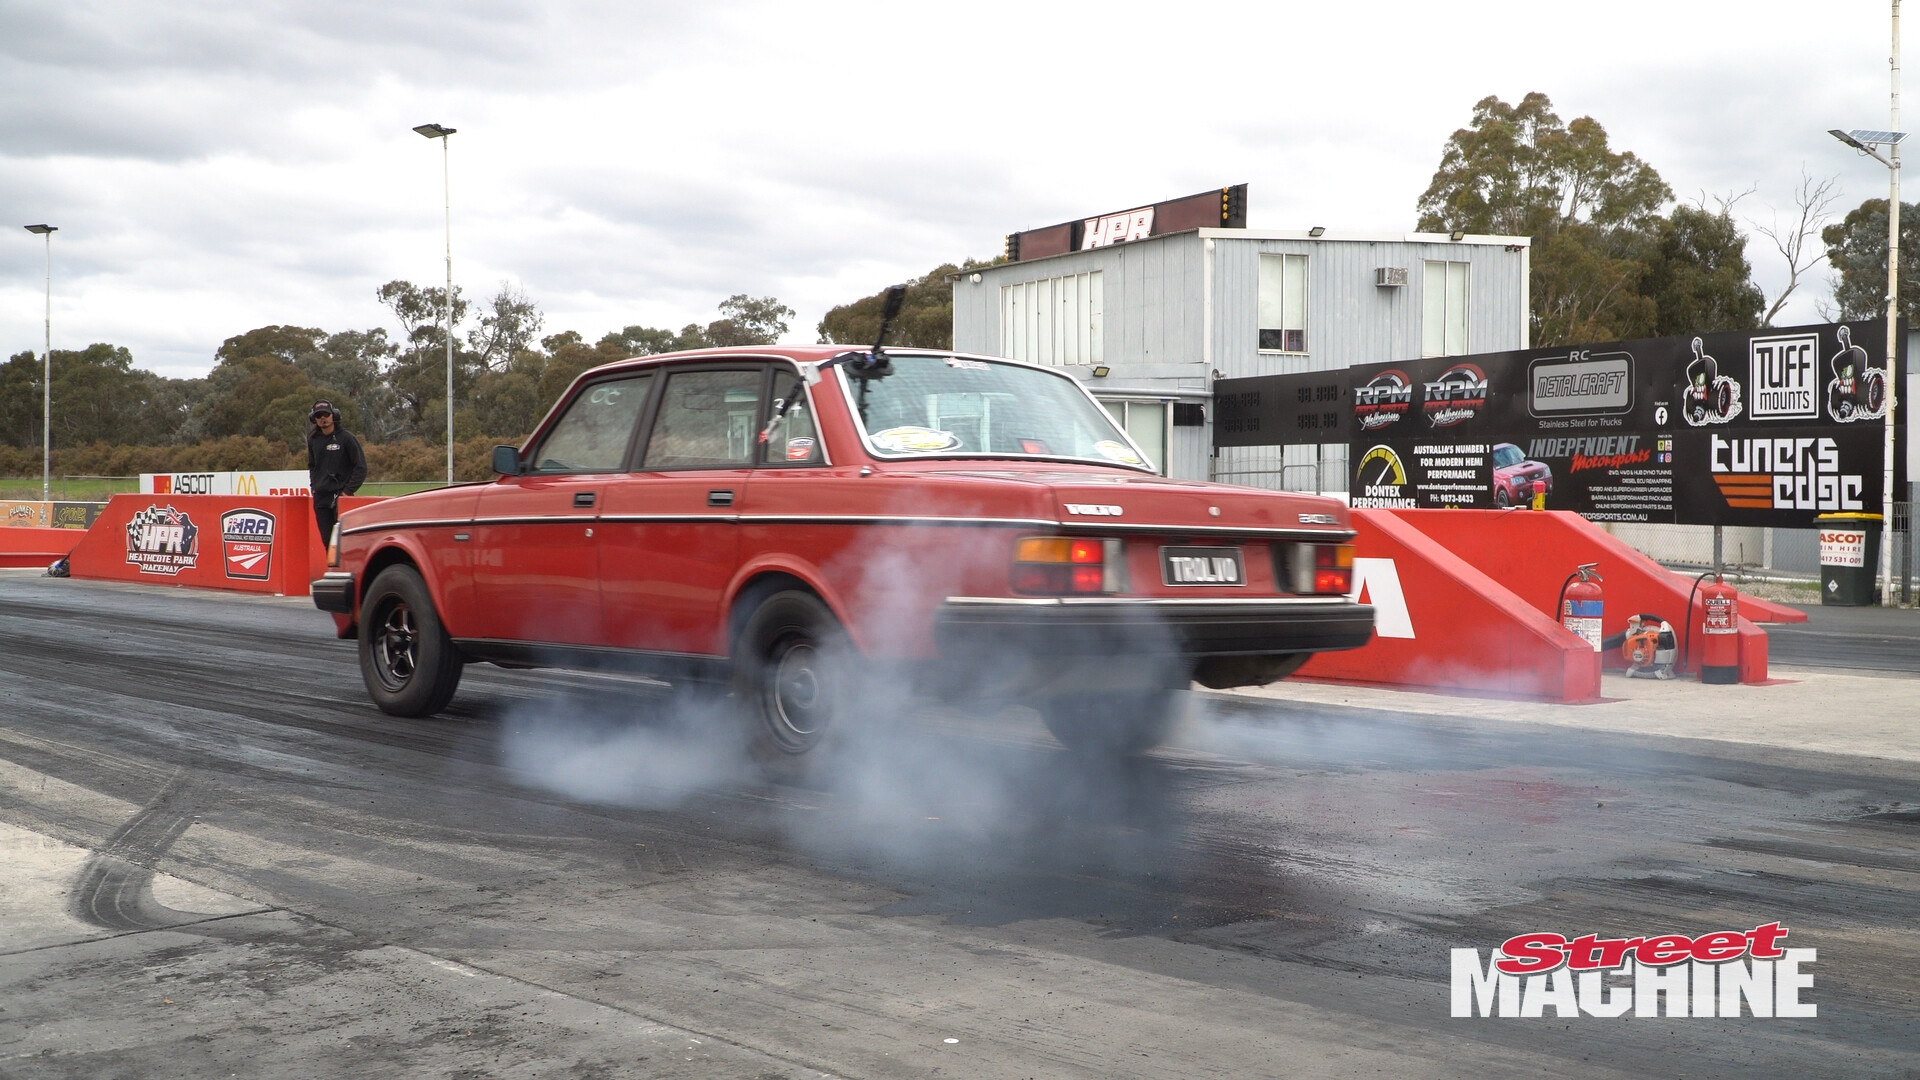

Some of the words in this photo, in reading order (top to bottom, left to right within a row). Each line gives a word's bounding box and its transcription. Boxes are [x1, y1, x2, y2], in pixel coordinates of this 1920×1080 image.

[1081, 206, 1154, 251] HPR
[1569, 350, 1590, 361] RC
[1756, 344, 1811, 389] TUFF
[1423, 379, 1488, 401] RPM
[1536, 371, 1625, 398] METALCRAFT
[1354, 384, 1412, 405] RPM
[1538, 420, 1569, 429] Stainless
[1570, 419, 1587, 428] Steel
[1587, 418, 1599, 427] for
[1600, 418, 1623, 427] Trucks
[1413, 445, 1454, 455] AUSTRALIA'S
[1455, 445, 1485, 454] NUMBER
[1486, 444, 1490, 453] 1
[1528, 435, 1640, 458] INDEPENDENT
[1420, 458, 1434, 467] FOR
[1434, 458, 1464, 467] MODERN
[1465, 457, 1483, 466] HEMI
[1570, 449, 1651, 474] Motorsports
[1427, 470, 1476, 479] PERFORMANCE
[174, 475, 215, 494] ASCOT
[1365, 485, 1401, 497] DONTEX
[1352, 497, 1416, 509] PERFORMANCE
[1440, 494, 1474, 503] 9873-8433
[1576, 513, 1648, 521] OTORSPORTS.COM.AU
[227, 518, 269, 534] IHRA
[140, 525, 185, 552] HPR
[1820, 533, 1864, 544] ASCOT
[233, 544, 261, 552] AUSTRALIA
[129, 553, 171, 563] HEATHCOTE
[173, 555, 194, 565] PARK
[142, 563, 179, 573] RACEWAY
